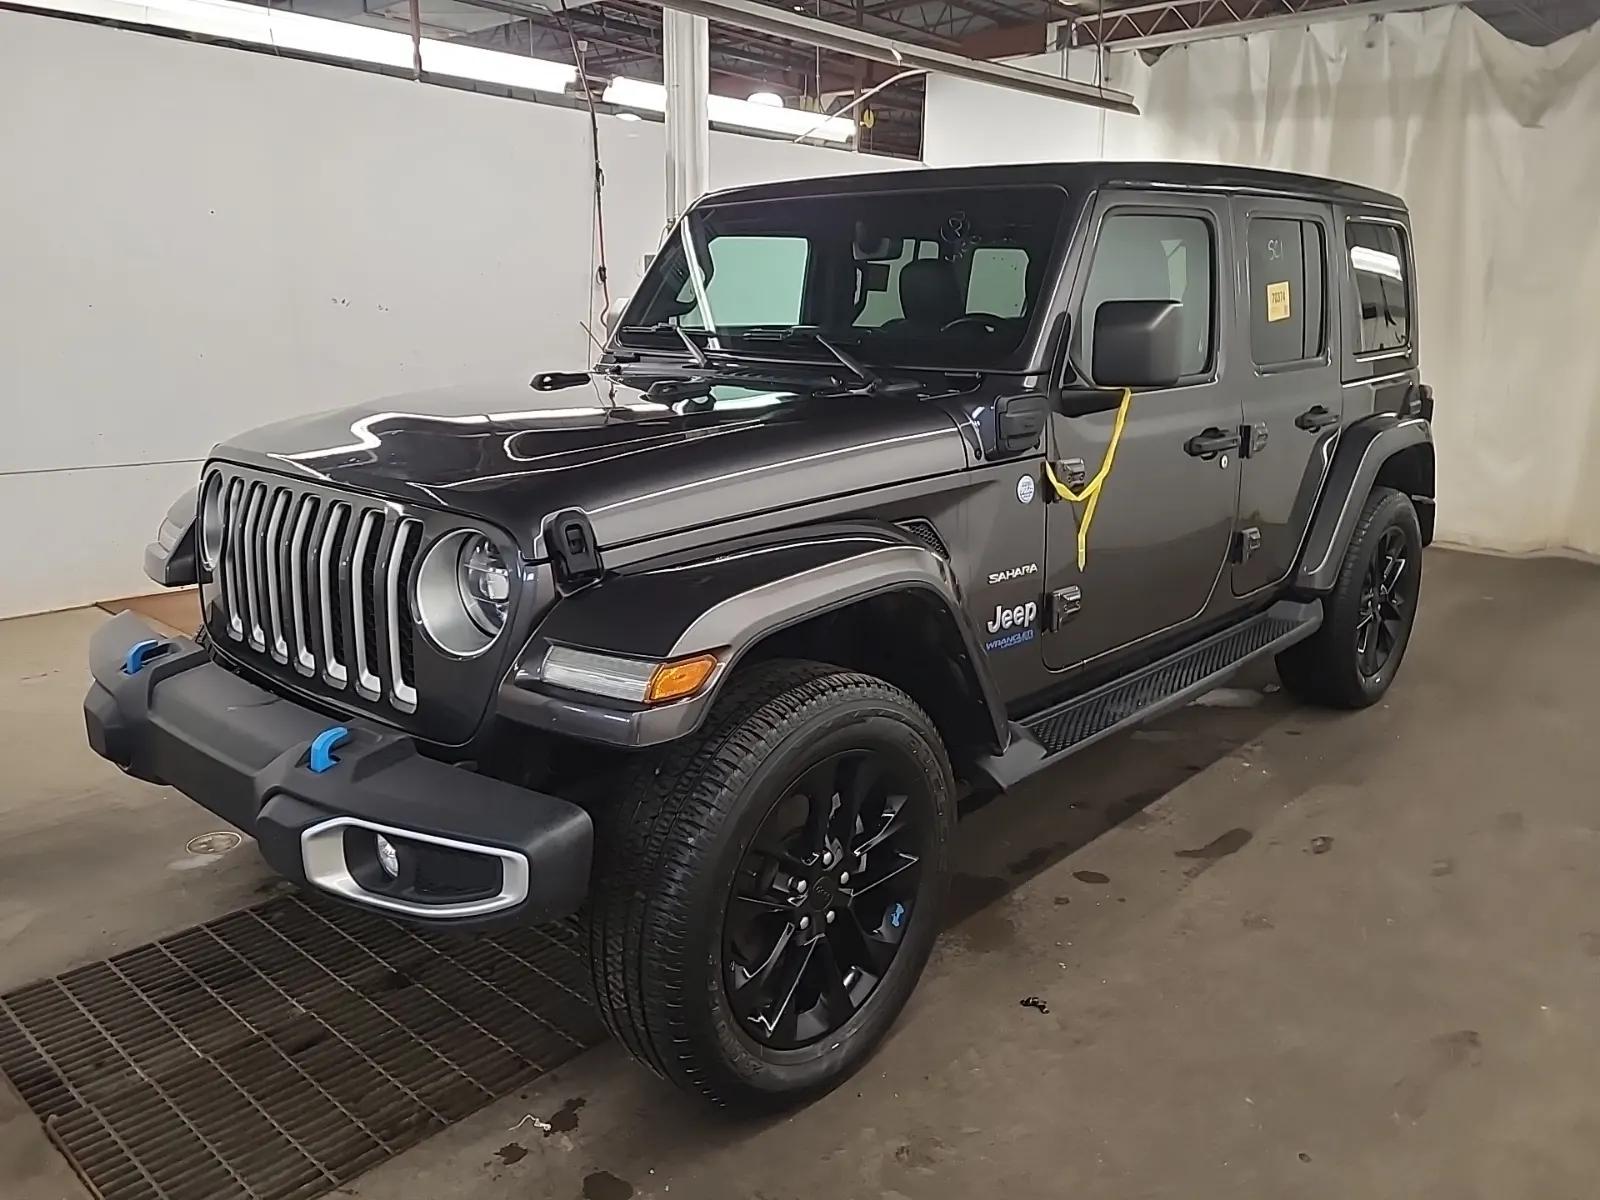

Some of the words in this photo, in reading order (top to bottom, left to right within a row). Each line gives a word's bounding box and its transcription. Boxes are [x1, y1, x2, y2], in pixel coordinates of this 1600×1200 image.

[988, 563, 1038, 584] SAHARA
[987, 601, 1037, 633] Jeep
[985, 629, 1034, 650] WRANGLER
